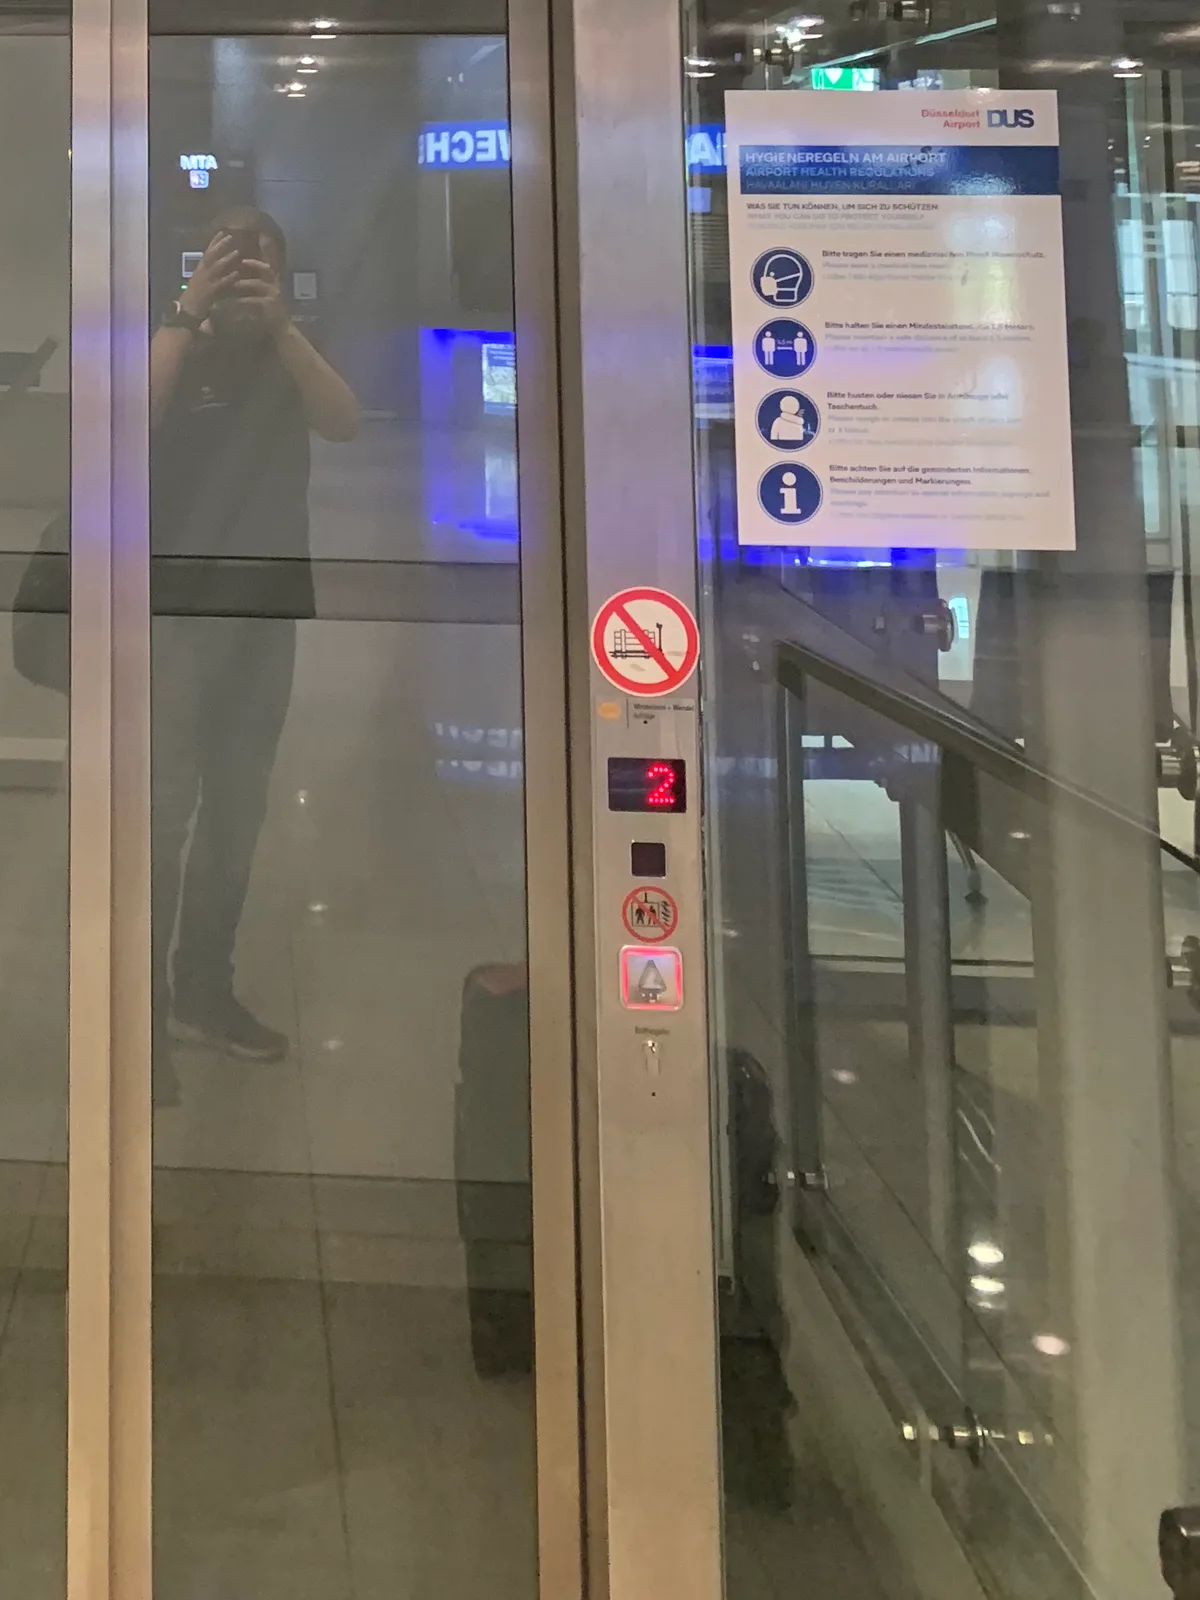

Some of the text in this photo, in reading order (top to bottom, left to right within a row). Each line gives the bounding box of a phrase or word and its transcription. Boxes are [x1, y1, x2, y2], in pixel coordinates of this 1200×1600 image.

[943, 119, 980, 130] Airport
[986, 109, 1035, 128] DUS
[745, 152, 948, 164] HYGIENEREGELN AM AIRPORT
[745, 166, 799, 177] AIRPORT
[801, 166, 848, 177] HEALTH
[647, 762, 676, 805] 2
